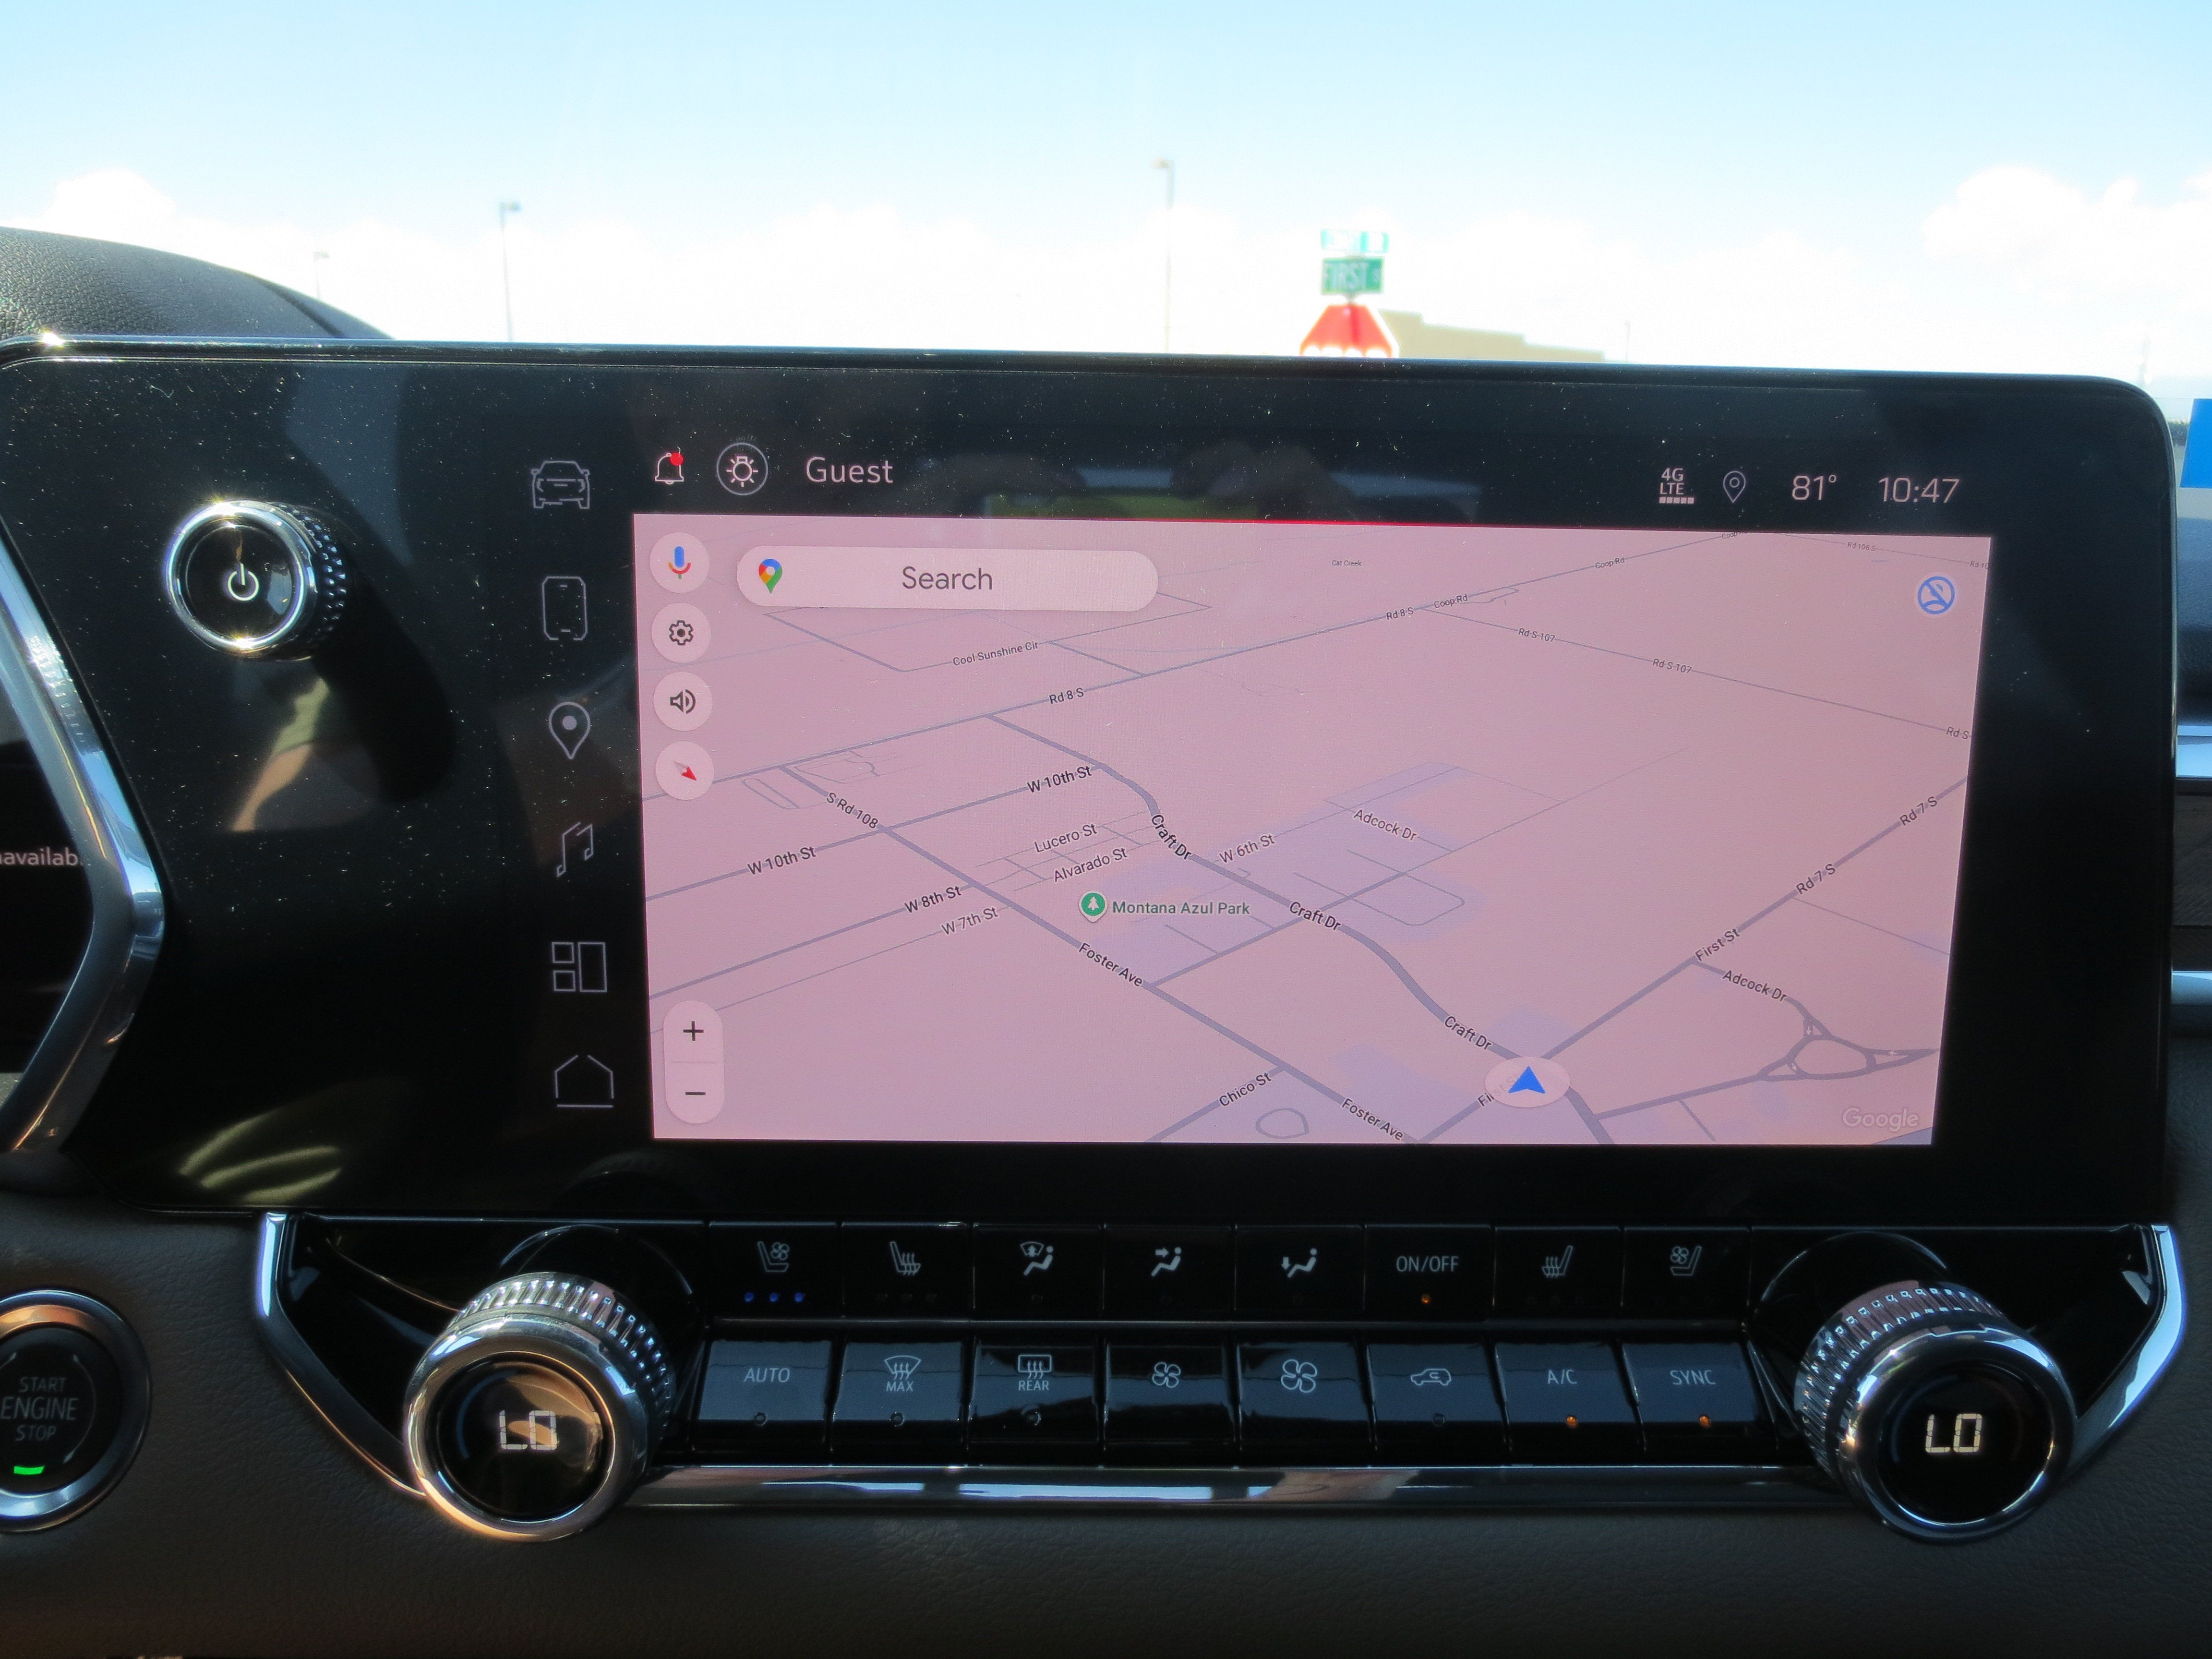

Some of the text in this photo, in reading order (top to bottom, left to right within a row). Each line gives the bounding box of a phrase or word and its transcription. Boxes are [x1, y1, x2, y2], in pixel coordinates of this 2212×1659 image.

[806, 457, 893, 483] Guest
[1661, 468, 1684, 481] 4G
[1659, 482, 1684, 494] LTE
[1792, 475, 1837, 500] 81°
[1878, 477, 1959, 504] 10:47
[1595, 557, 1625, 570] Coop Rd
[902, 566, 993, 590] Search
[1386, 607, 1414, 620] Rd 8 S
[1434, 594, 1468, 609] Coop Rd
[1518, 628, 1530, 637] Rd
[1540, 633, 1556, 642] 107
[953, 640, 1038, 666] Cool Sunshine Cir
[1652, 658, 1692, 673] Rd S 107
[1049, 687, 1084, 704] Rd 8 S
[1946, 726, 1969, 740] Rd S
[1027, 766, 1092, 793] W 10th St
[826, 792, 879, 829] S Rd 108
[1899, 796, 1938, 826] Rd 7 S
[1152, 814, 1192, 860] Craft Dr
[1354, 809, 1417, 841] Adcock Dr
[1034, 824, 1097, 853] Lucero St
[1220, 834, 1275, 864] W 6th St
[0, 847, 83, 866] availab
[747, 846, 816, 875] W 10th St
[1054, 848, 1127, 882] Alvarado St
[1796, 864, 1836, 894] Rd 7 S
[905, 886, 962, 913] W 8th St
[1113, 902, 1250, 914] Montana Azul Park
[941, 907, 998, 935] W 7th St
[1289, 901, 1341, 931] Craft Dr
[1695, 928, 1740, 962] First St
[1079, 943, 1142, 986] Foster Ave
[1723, 971, 1787, 1002] Adcock Dr
[1444, 1016, 1491, 1050] Craft Dr
[1219, 1072, 1272, 1106] Chico St
[1342, 1098, 1404, 1140] Foster Ave
[1842, 1107, 1918, 1132] Google
[1396, 1256, 1459, 1272] ON/OFF
[20, 1377, 67, 1392] START
[744, 1367, 790, 1383] AUTO
[886, 1381, 913, 1392] MAX
[1018, 1380, 1049, 1391] REAR
[1547, 1369, 1577, 1385] A/C
[1670, 1370, 1716, 1385] SYNC
[1, 1396, 79, 1420] ENGINE
[16, 1425, 56, 1441] STOP
[499, 1409, 558, 1451] LO
[1925, 1413, 1983, 1453] LO
